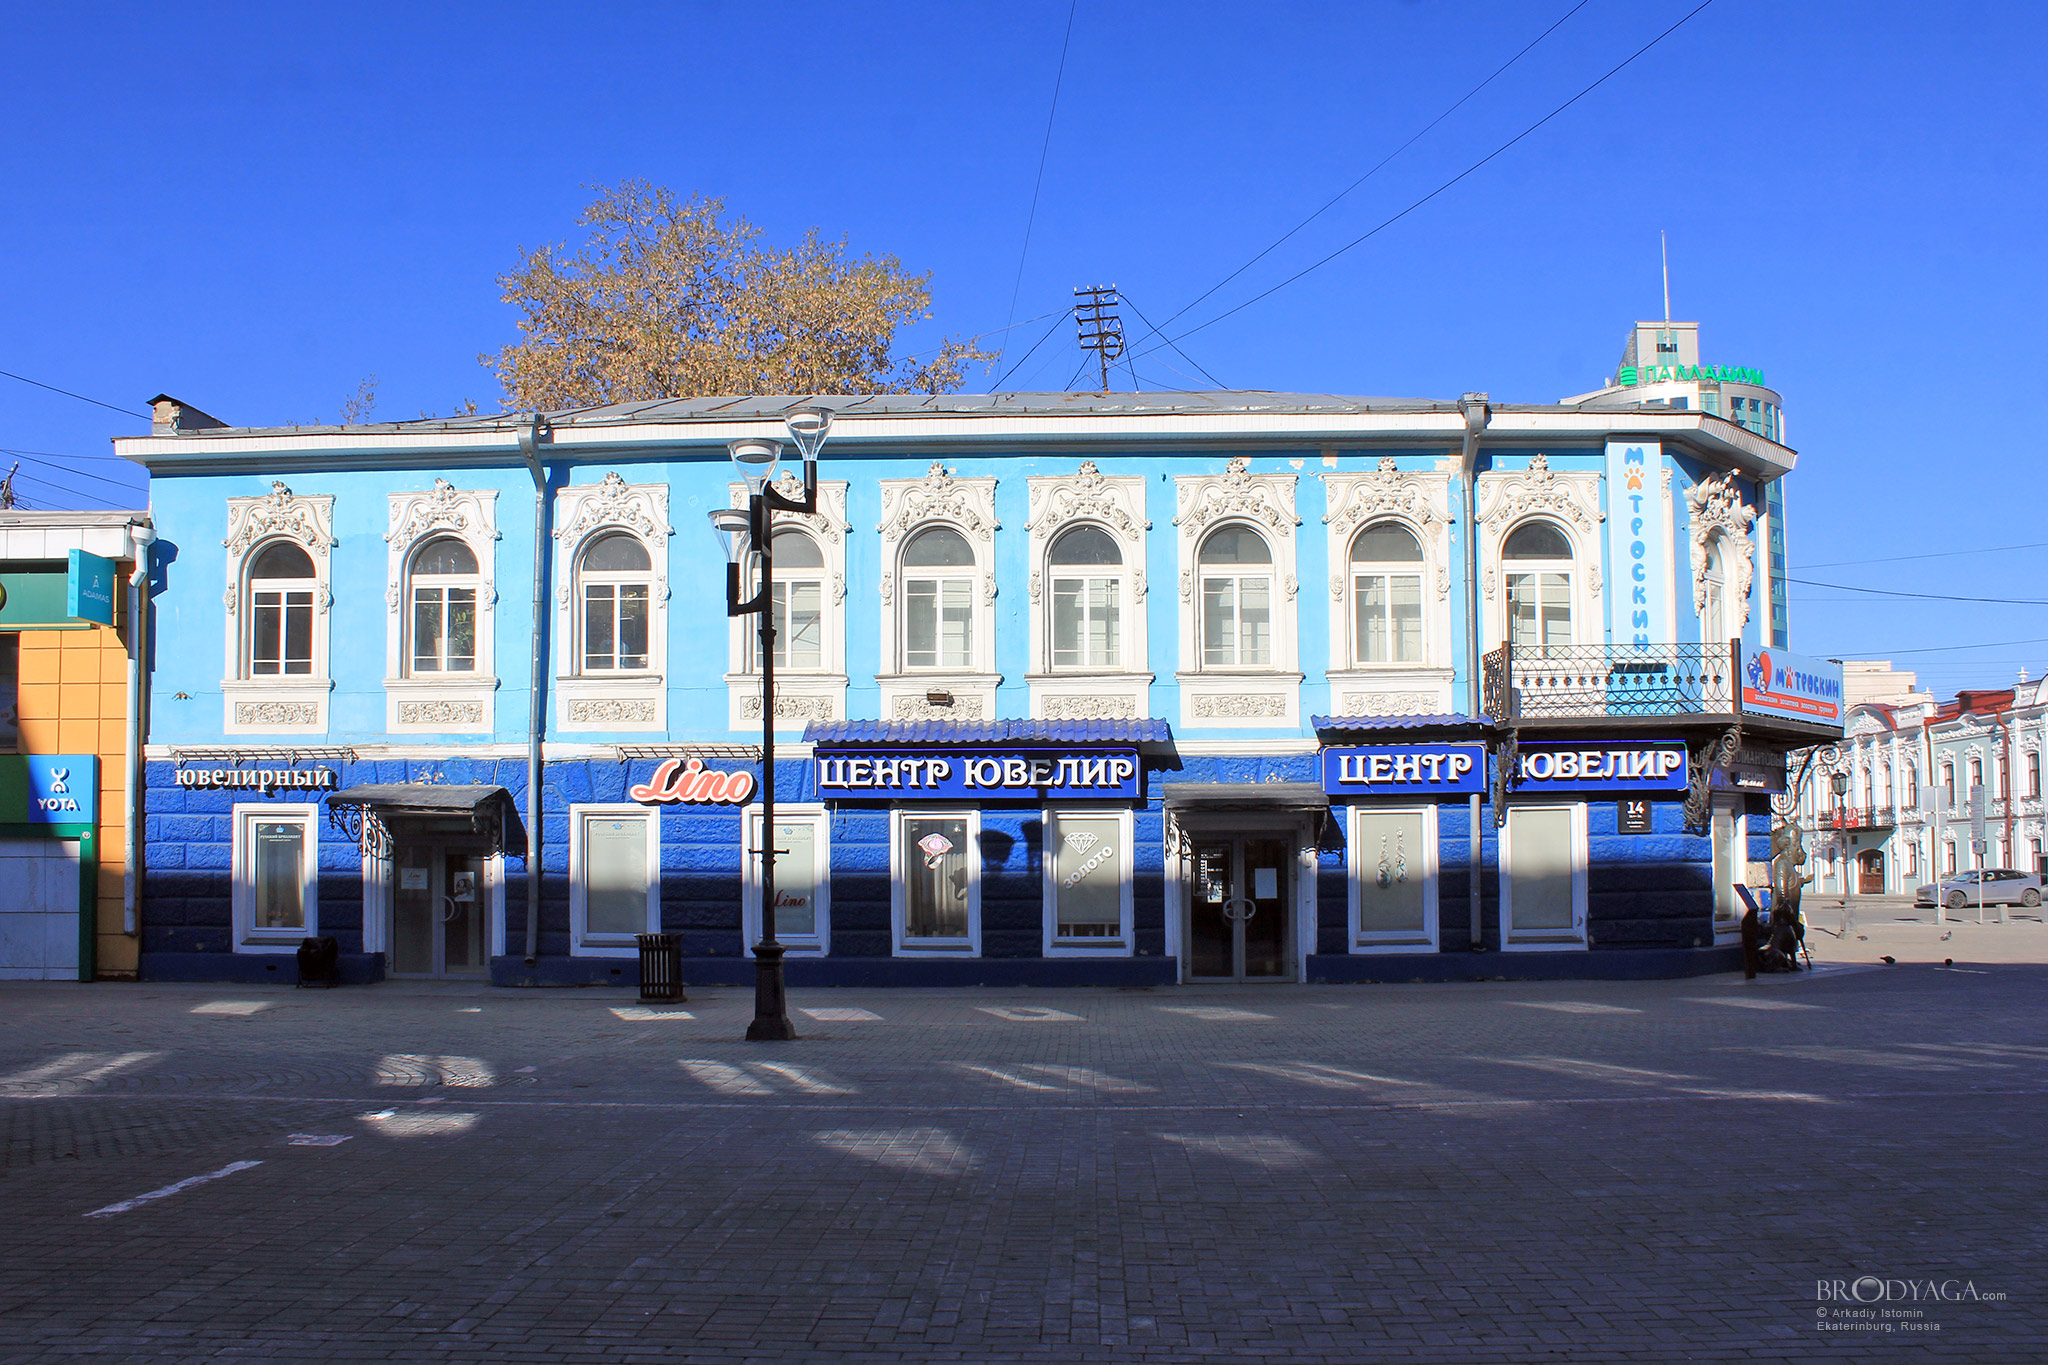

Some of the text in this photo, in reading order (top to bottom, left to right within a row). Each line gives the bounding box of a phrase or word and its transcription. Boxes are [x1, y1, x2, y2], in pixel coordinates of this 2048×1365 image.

[1644, 364, 1764, 386] ПАЛЛАДИУМ
[82, 589, 110, 604] ADAMAS
[1775, 666, 1839, 699] МАТРОСКИН
[174, 765, 331, 792] ювелирный
[818, 758, 1134, 789] ЦЕНТР ЮВЕЛИР
[1338, 753, 1473, 784] ЦЕНТР
[1518, 751, 1682, 780] ЮВЕЛИР
[629, 758, 755, 804] Lino
[37, 798, 78, 811] YOTA
[1627, 801, 1645, 814] 14
[1063, 845, 1114, 889] ЗОЛОТО
